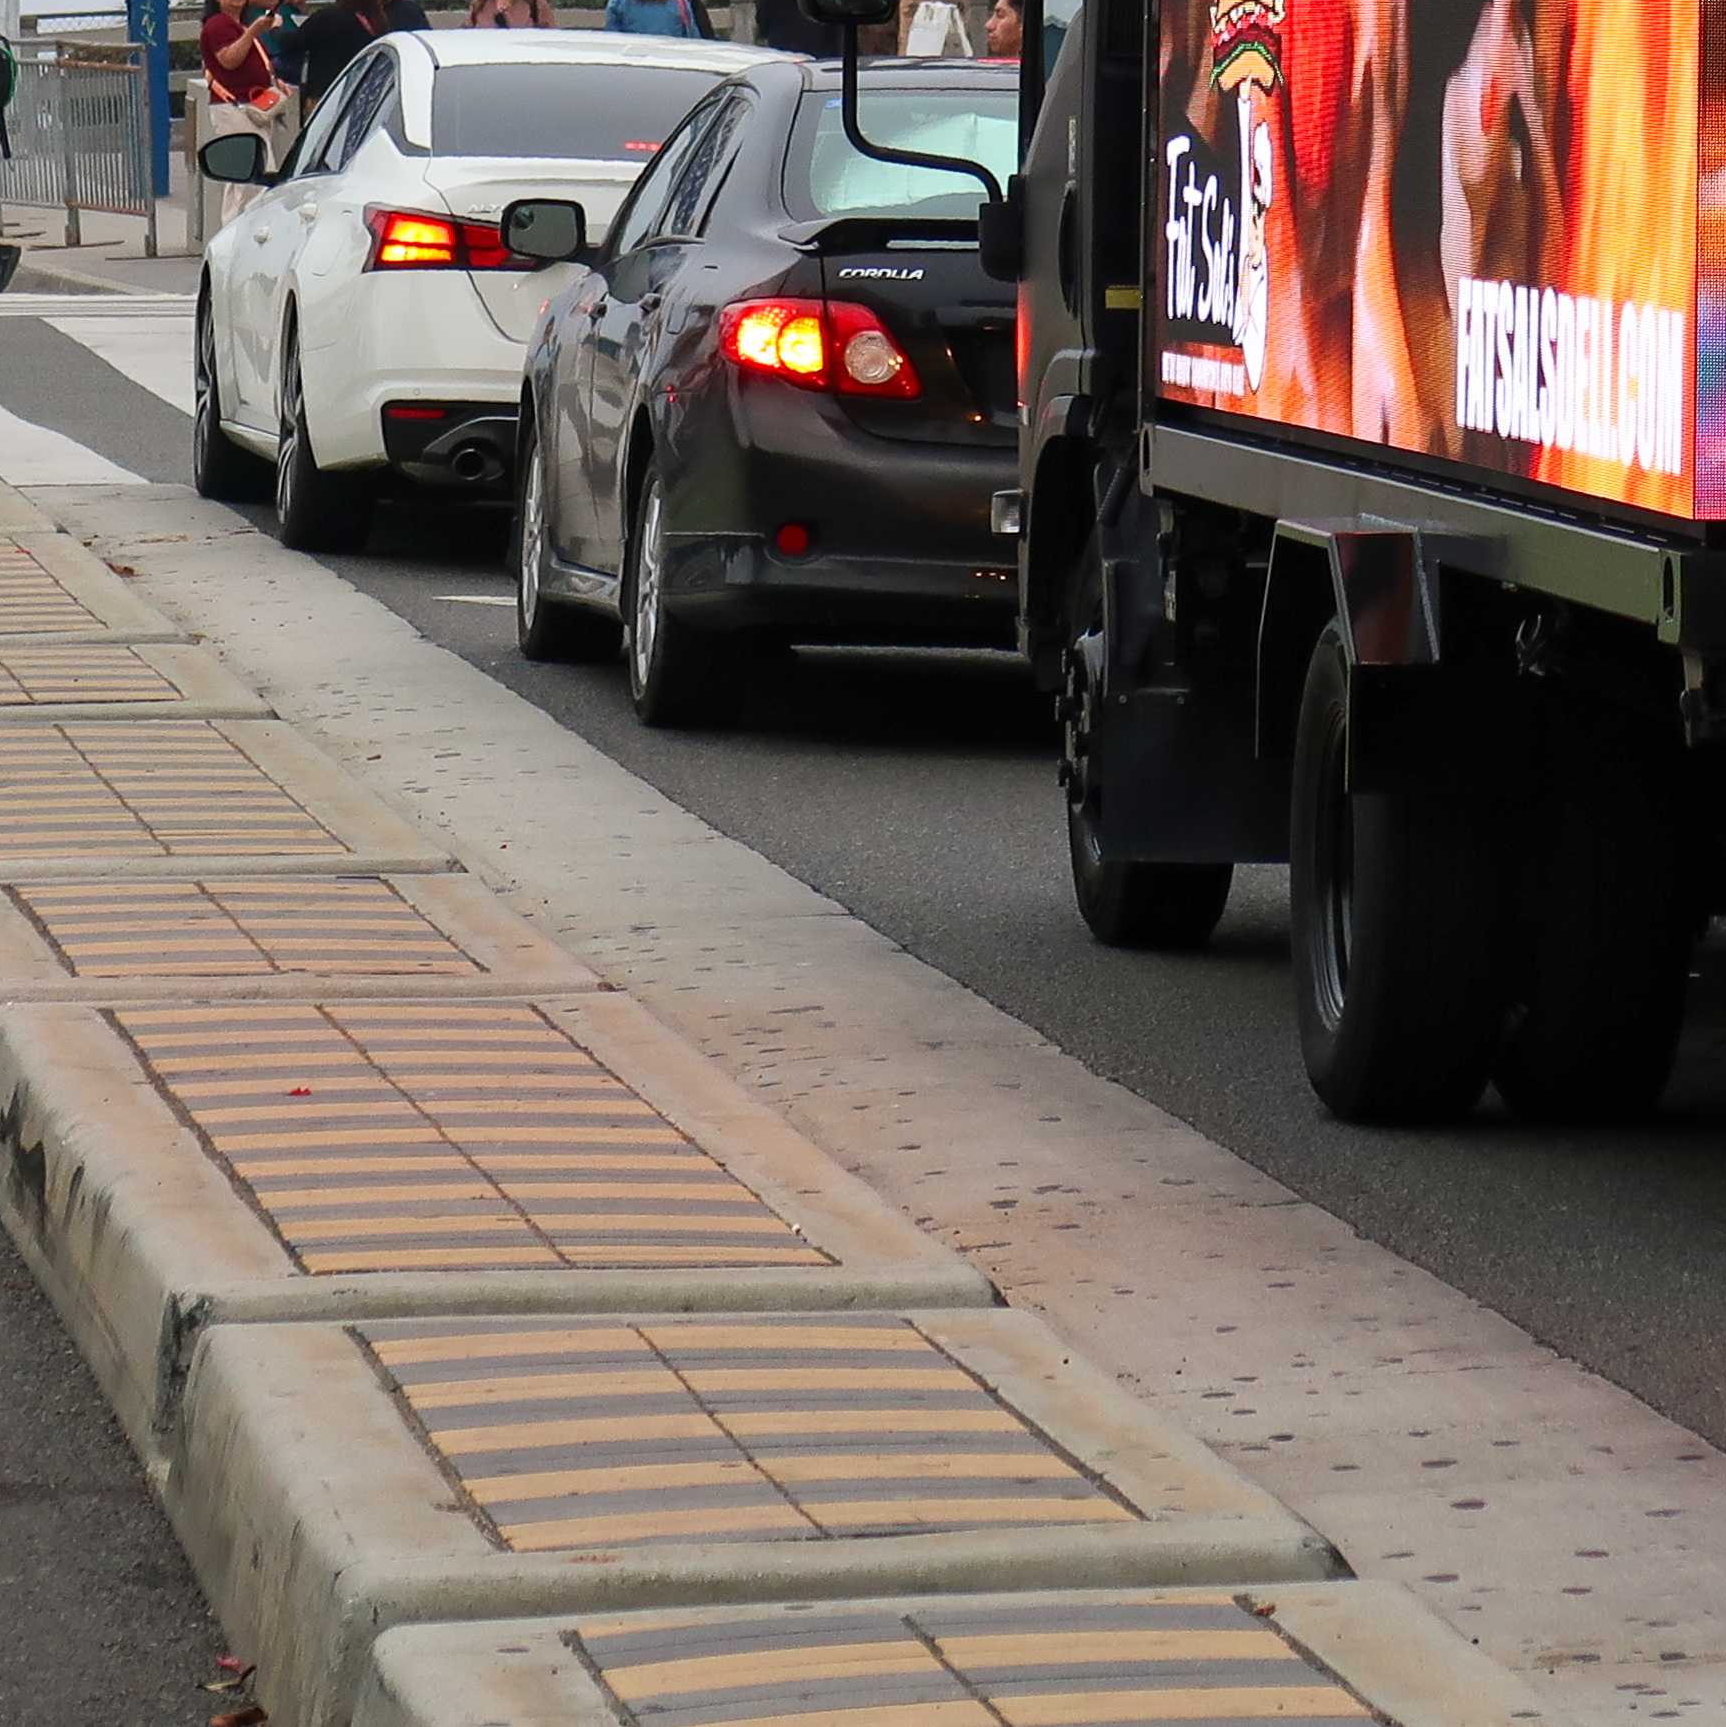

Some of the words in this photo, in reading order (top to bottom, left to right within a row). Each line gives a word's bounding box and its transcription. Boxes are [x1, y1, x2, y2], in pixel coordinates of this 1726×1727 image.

[467, 203, 504, 214] ALT
[1166, 135, 1203, 320] Fat
[838, 267, 925, 281] COROLLA
